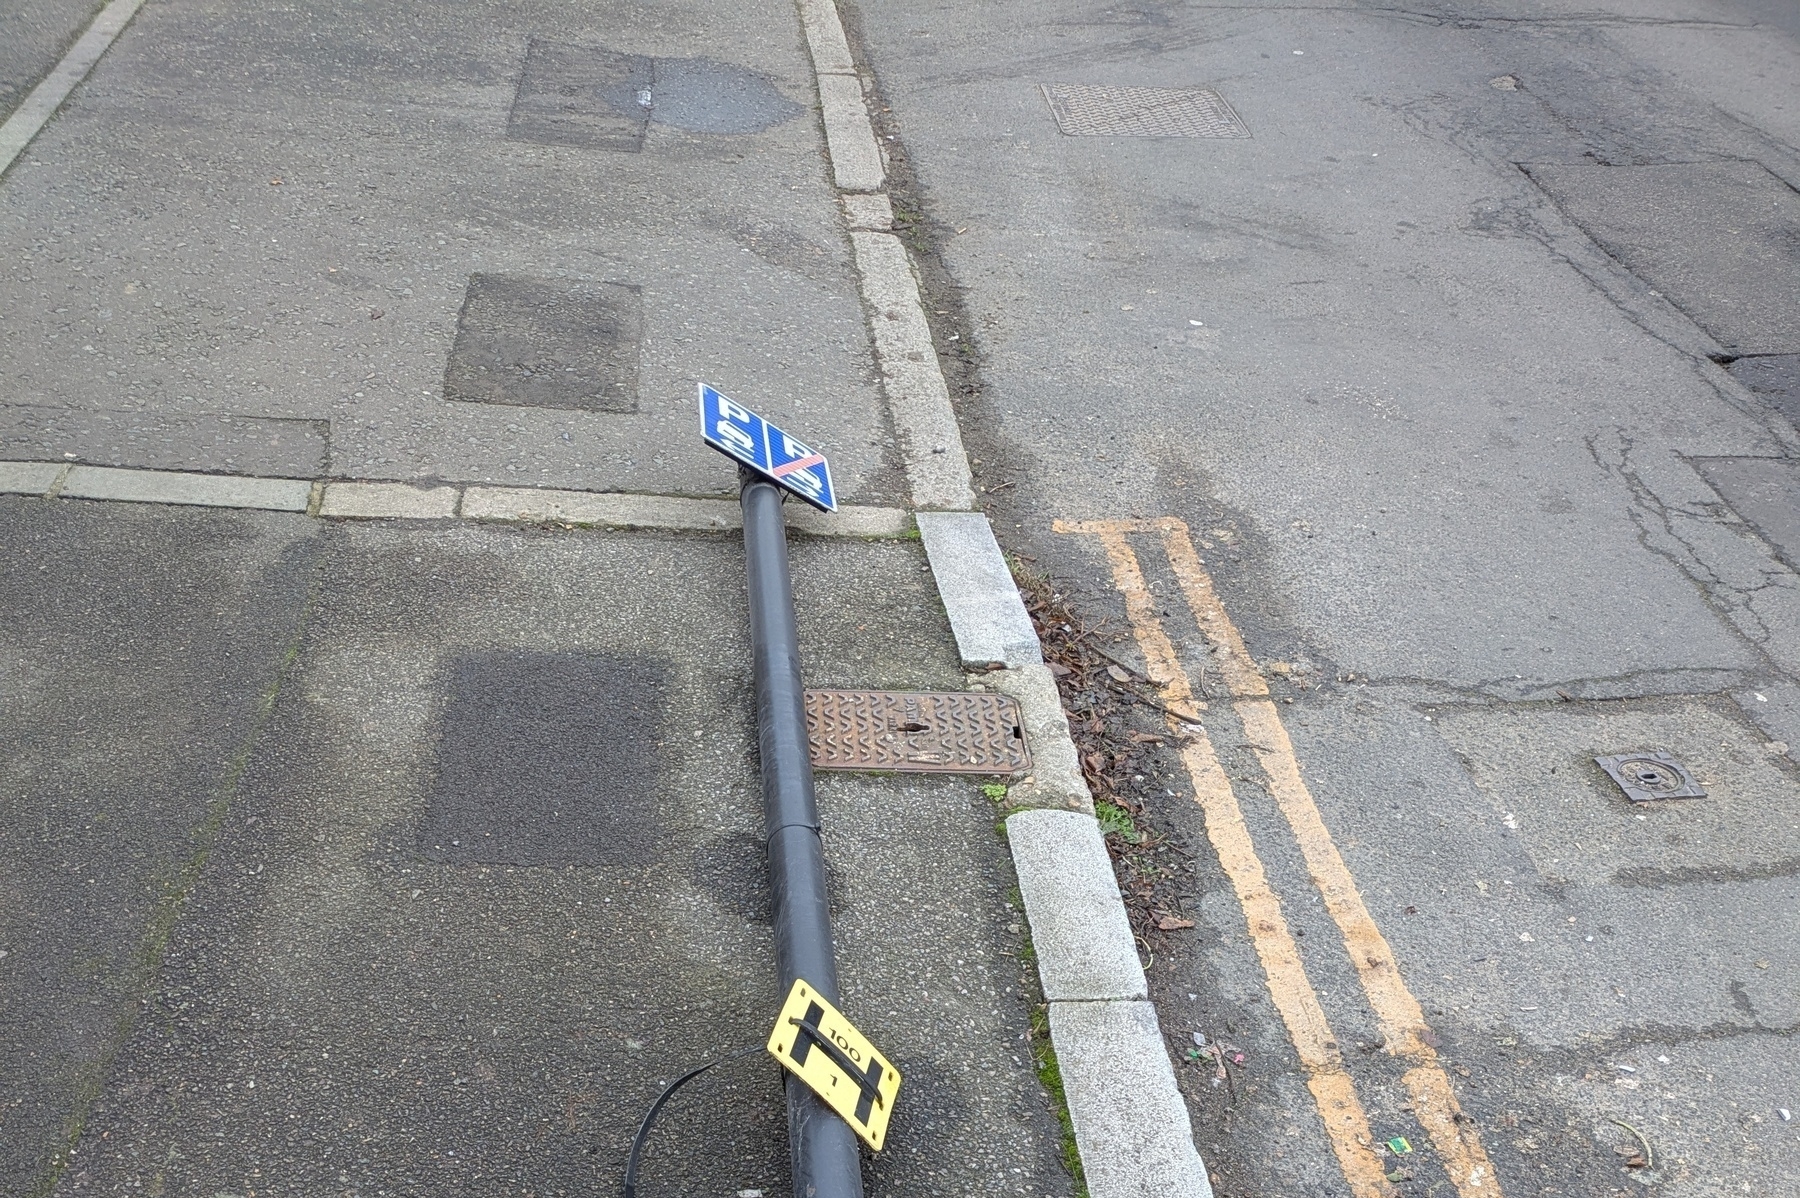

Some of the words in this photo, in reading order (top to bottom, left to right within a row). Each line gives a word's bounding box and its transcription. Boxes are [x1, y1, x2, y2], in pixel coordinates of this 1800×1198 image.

[717, 395, 751, 424] P
[782, 434, 812, 459] P
[828, 1026, 862, 1063] 100
[829, 1073, 839, 1088] 1
